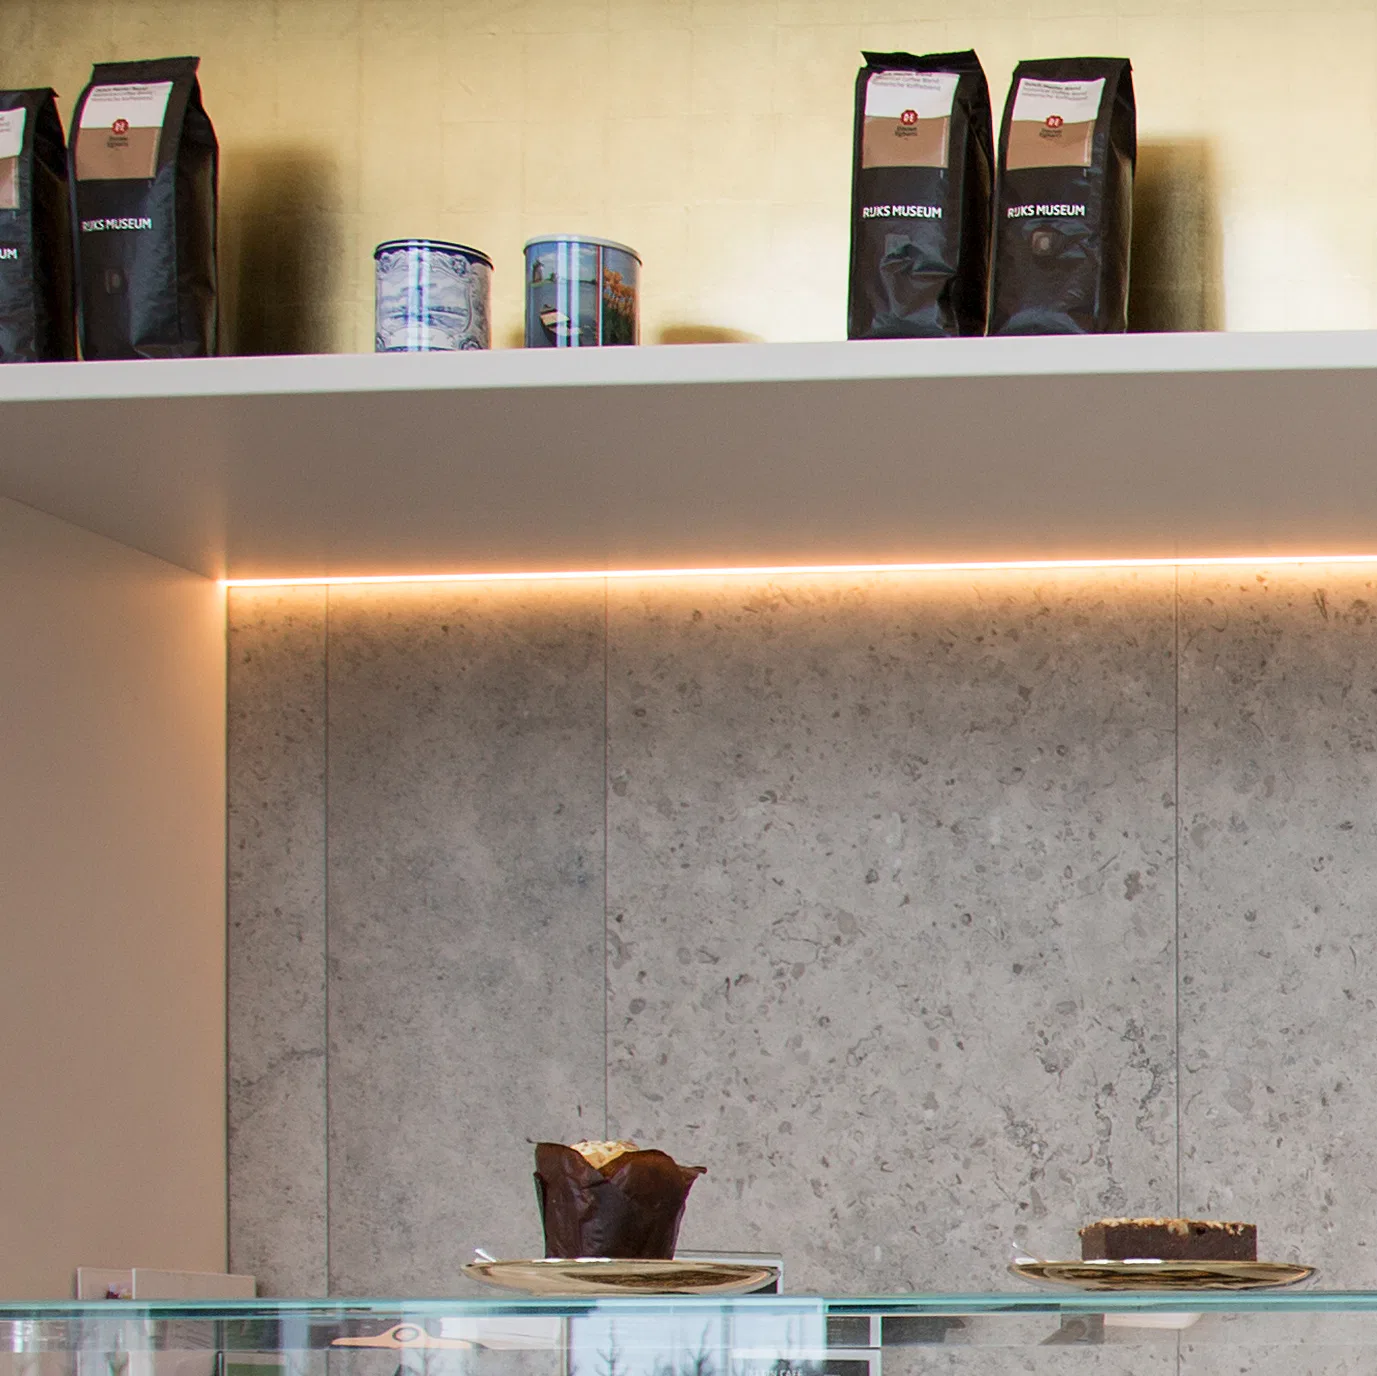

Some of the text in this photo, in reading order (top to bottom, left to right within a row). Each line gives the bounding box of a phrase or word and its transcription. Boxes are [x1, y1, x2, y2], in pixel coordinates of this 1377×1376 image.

[892, 205, 942, 219] MUSEUM
[1036, 204, 1085, 217] MUSEUM
[106, 218, 152, 231] MUSEUM
